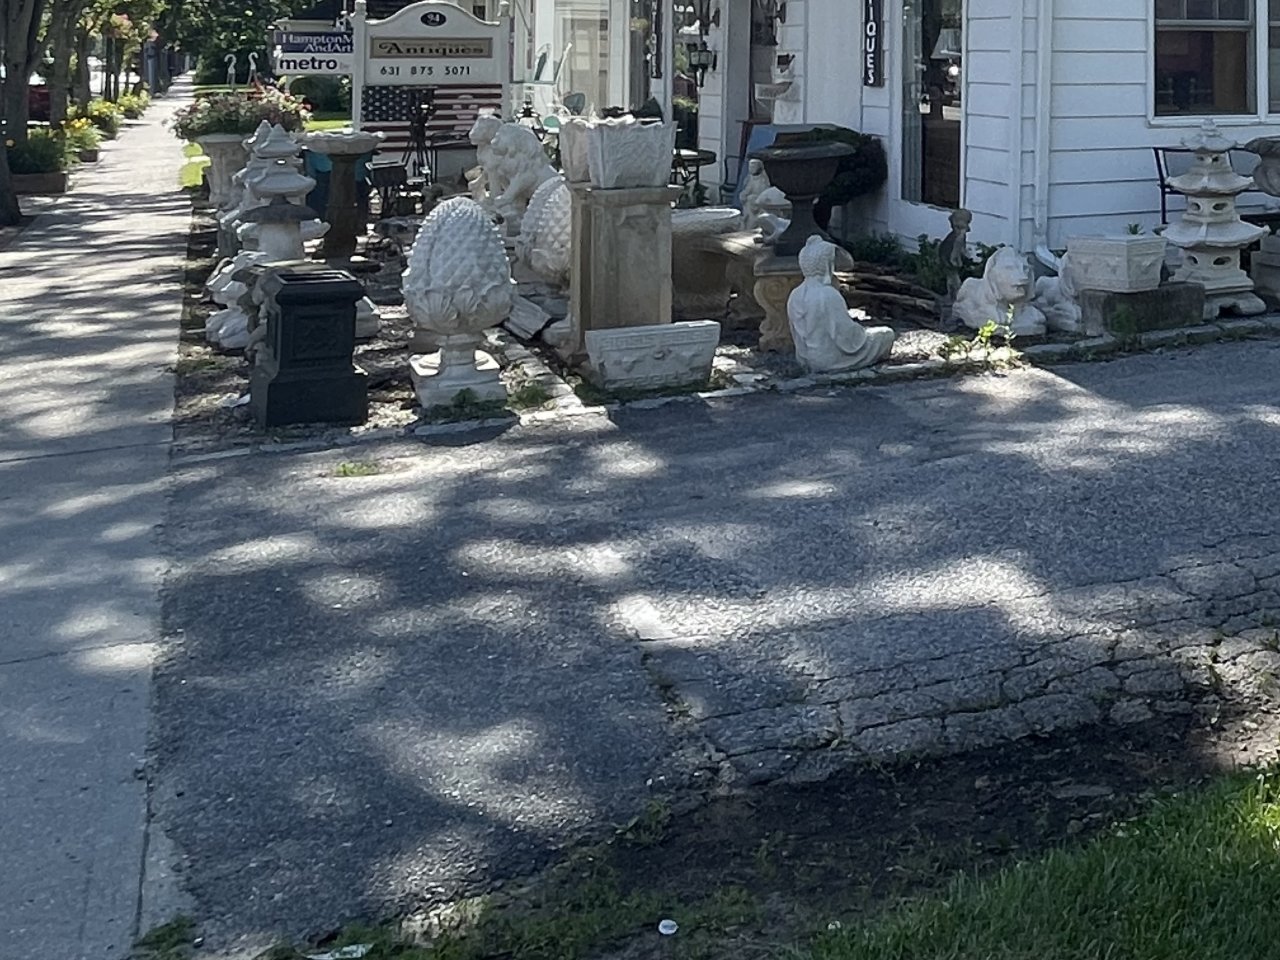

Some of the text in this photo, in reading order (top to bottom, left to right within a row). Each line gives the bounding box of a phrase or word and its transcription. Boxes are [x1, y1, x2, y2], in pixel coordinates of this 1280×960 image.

[379, 42, 484, 56] Antiques
[280, 56, 338, 70] metro
[380, 66, 471, 76] 631 875 5071
